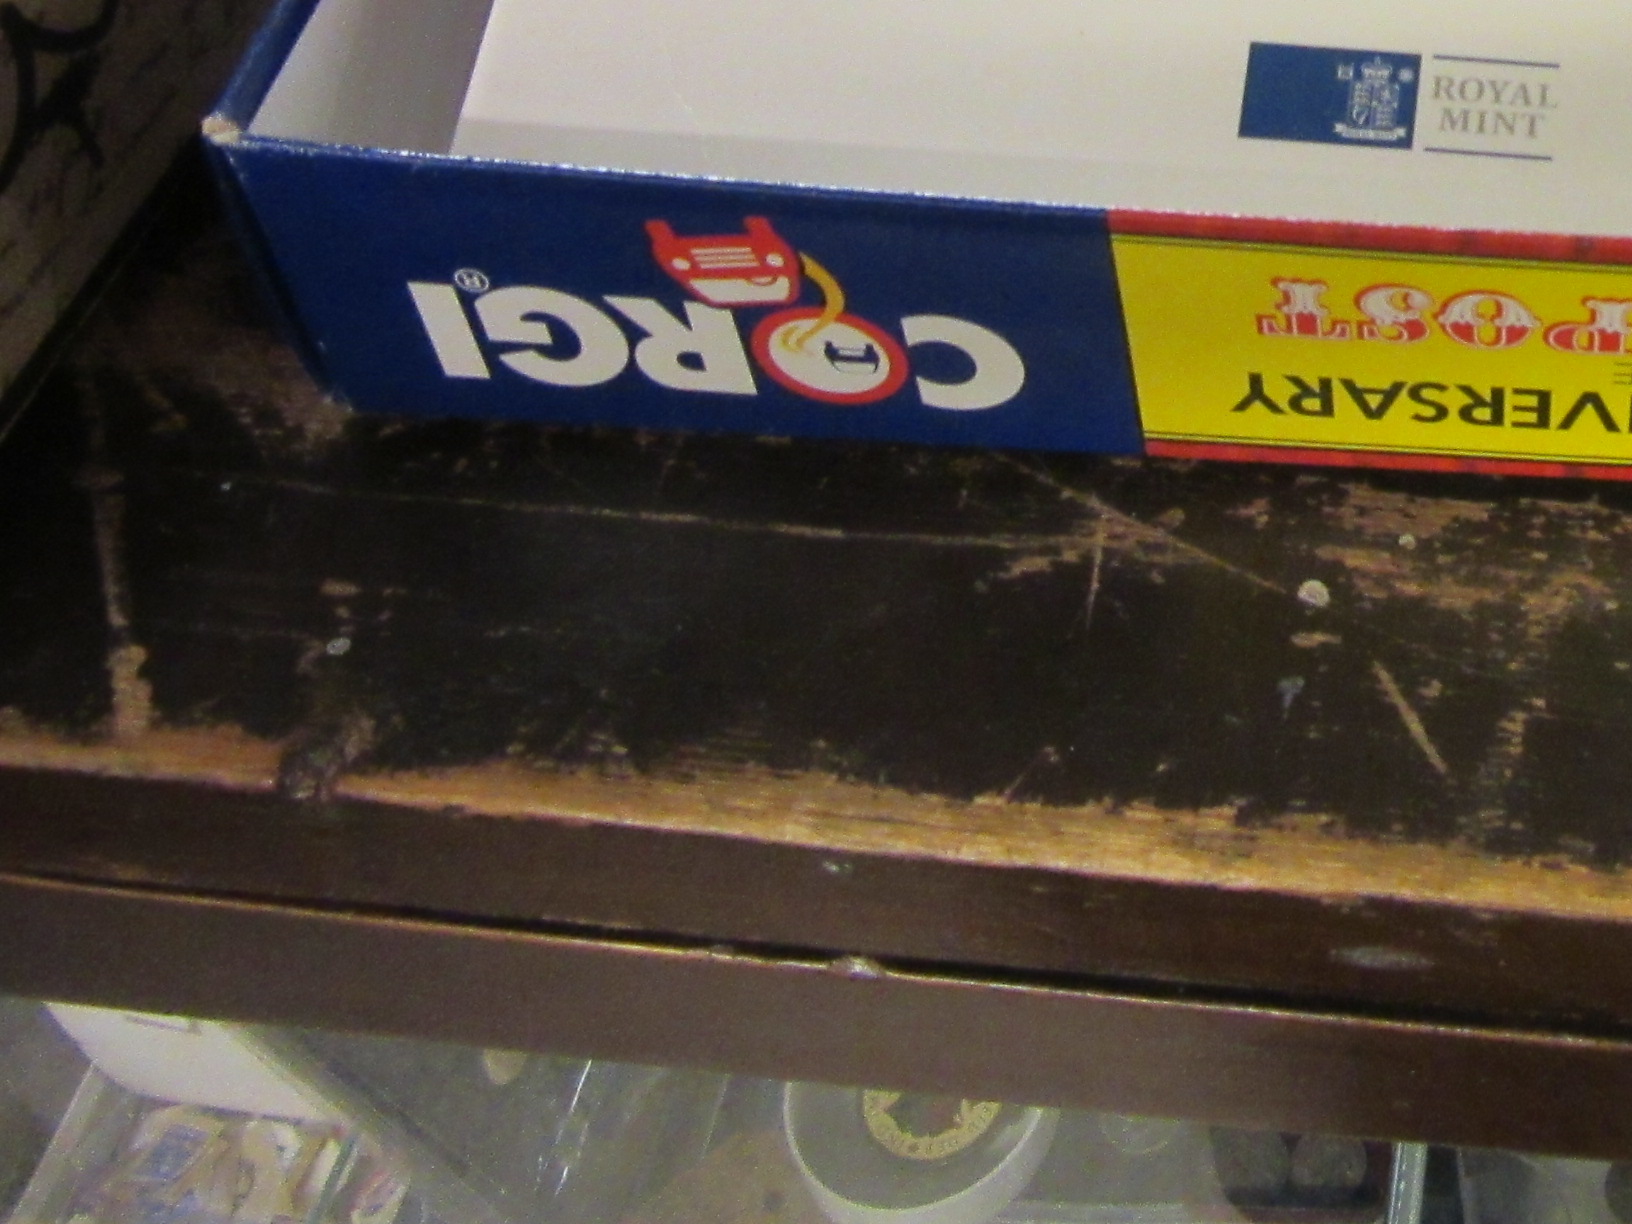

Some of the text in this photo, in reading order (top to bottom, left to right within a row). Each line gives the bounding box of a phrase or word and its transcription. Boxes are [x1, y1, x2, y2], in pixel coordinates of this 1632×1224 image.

[1431, 74, 1559, 110] ROYAL
[1438, 107, 1547, 140] MINT
[406, 279, 1026, 412] CORGI
